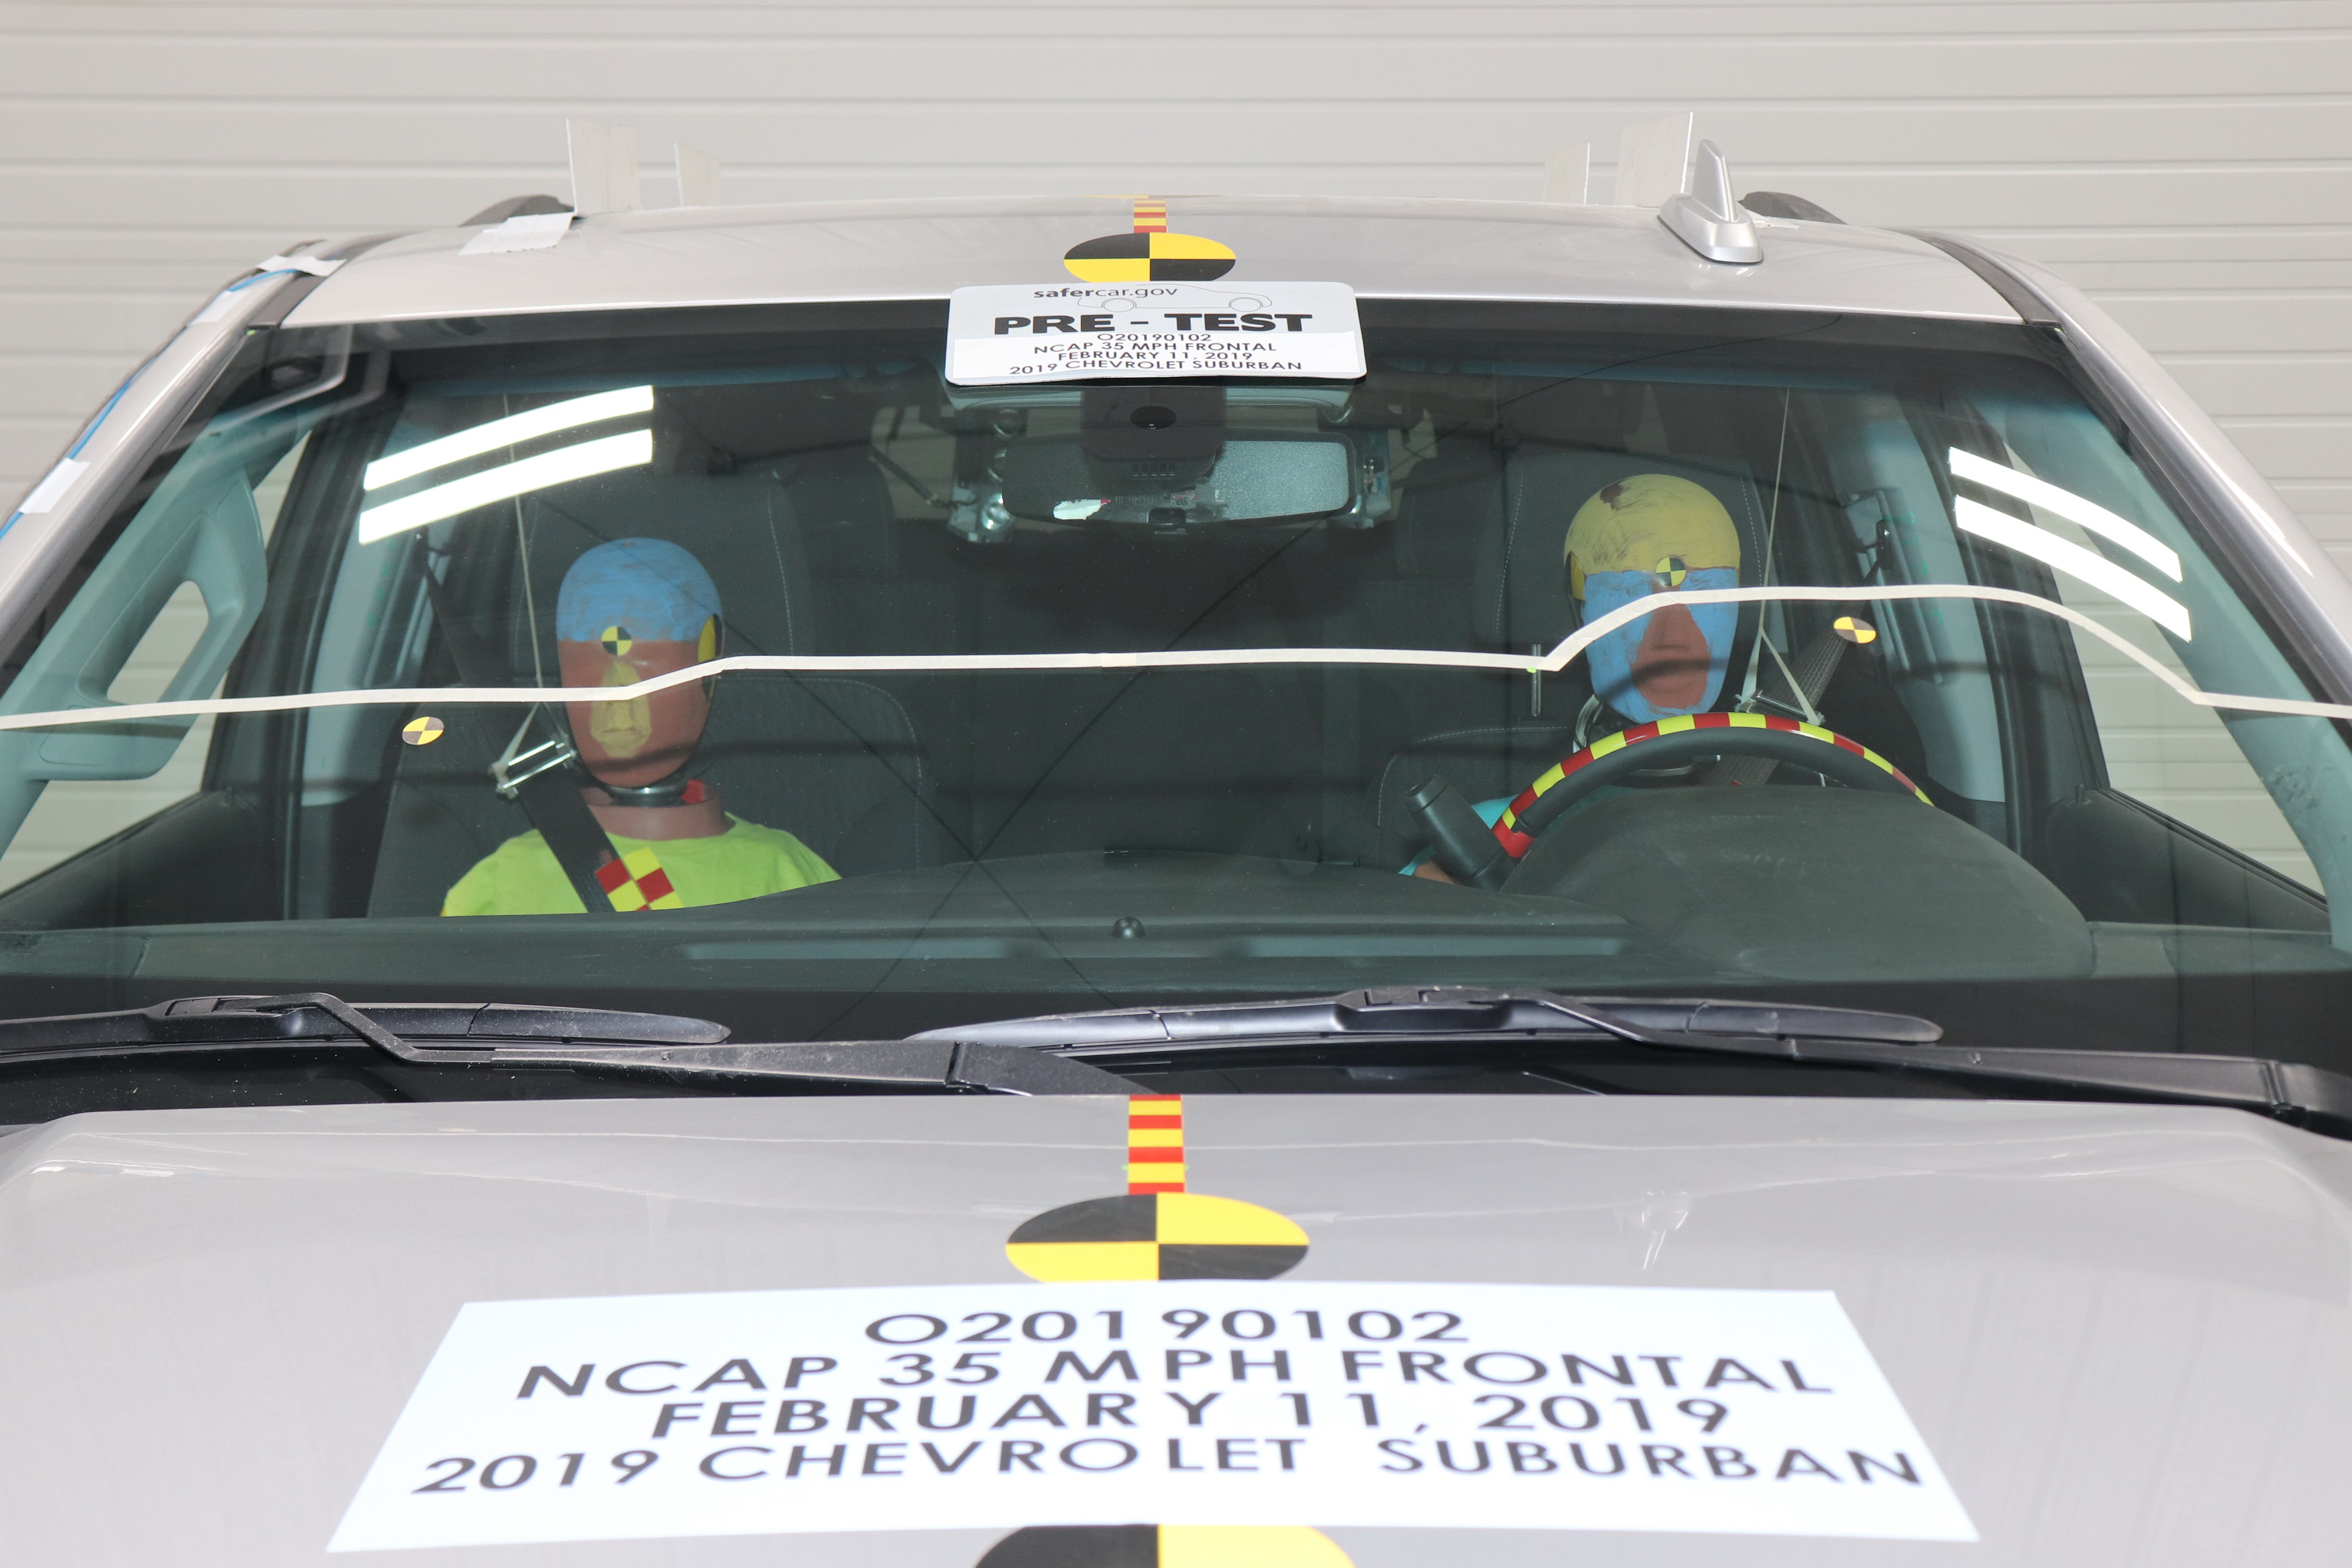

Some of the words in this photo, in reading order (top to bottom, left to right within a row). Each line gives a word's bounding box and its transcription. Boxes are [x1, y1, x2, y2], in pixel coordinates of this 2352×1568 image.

[1033, 286, 1178, 298] safercar.gov
[994, 314, 1115, 334] PRE
[1164, 313, 1313, 332] TEST
[1034, 342, 1094, 354] NCAP
[1058, 351, 1159, 361] FEBRUARY
[1169, 352, 1197, 362] 11,
[1009, 363, 1057, 375] 2019
[1065, 360, 1184, 369] CHEVROLET
[1193, 360, 1302, 370] SUBURBAN
[516, 1356, 839, 1399] NCAP
[879, 1352, 1001, 1386] 35
[1044, 1349, 1291, 1382] MPH
[1341, 1350, 1832, 1392] FRONTAL
[651, 1392, 1221, 1438] FEBRUARY
[1473, 1394, 1728, 1433] 2019
[412, 1449, 659, 1494] 2019
[698, 1438, 1306, 1480] CHEVROLET
[1378, 1439, 1921, 1484] SUBURBAN
